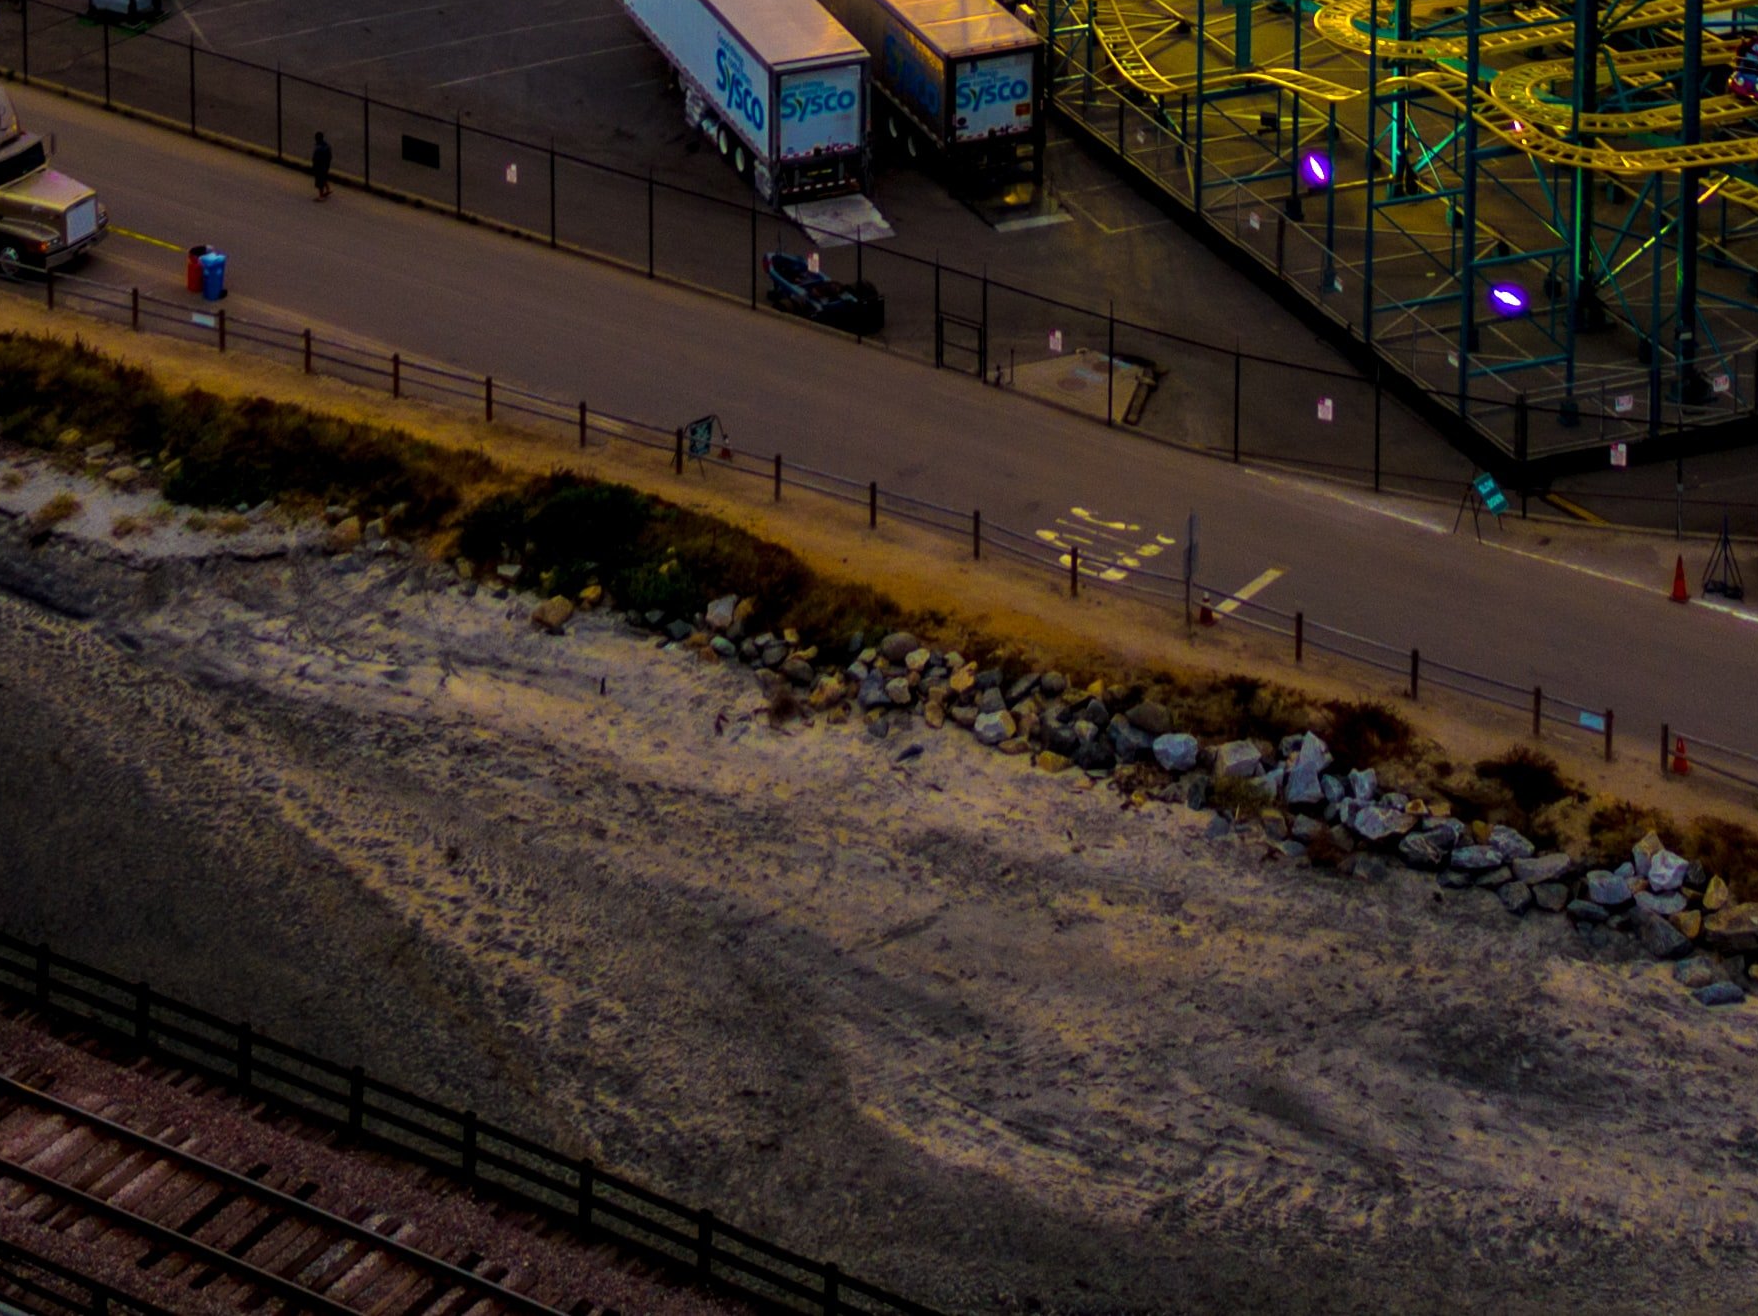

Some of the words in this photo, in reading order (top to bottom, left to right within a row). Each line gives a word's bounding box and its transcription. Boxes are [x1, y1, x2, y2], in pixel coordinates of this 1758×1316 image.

[715, 47, 764, 131] Sysco
[780, 89, 856, 123] Sysco
[956, 78, 1029, 112] Sysco
